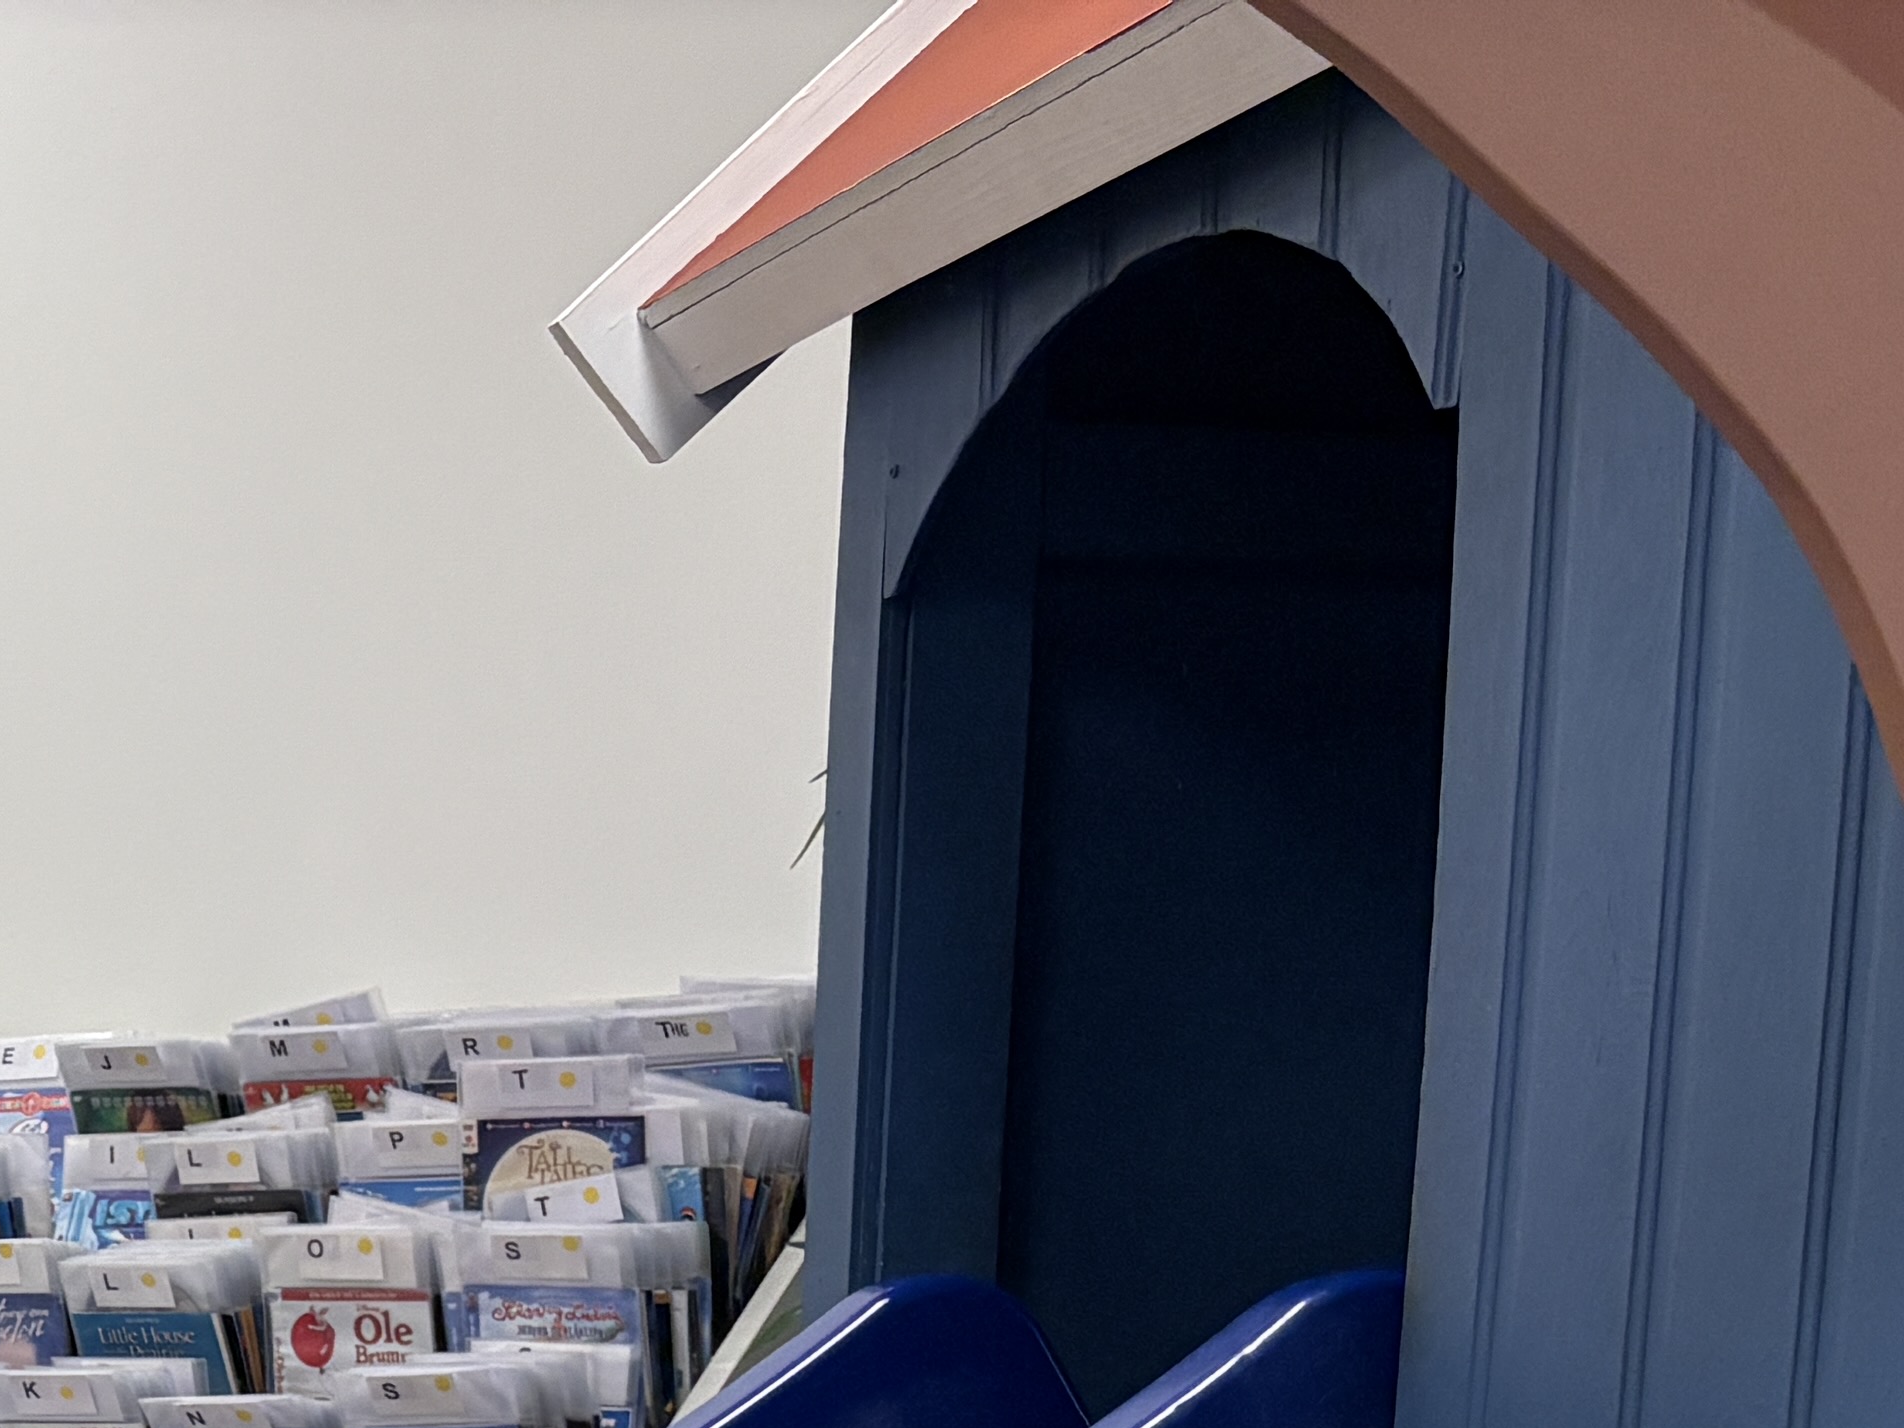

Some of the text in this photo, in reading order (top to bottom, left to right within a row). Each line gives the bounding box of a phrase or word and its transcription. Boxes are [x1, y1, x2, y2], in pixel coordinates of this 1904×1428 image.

[269, 1039, 288, 1057] M
[462, 1038, 480, 1055] R
[2, 1048, 15, 1064] E
[101, 1055, 112, 1070] J
[512, 1069, 528, 1089] T
[389, 1131, 405, 1150] P
[187, 1149, 202, 1167] L
[533, 1196, 550, 1217] T
[308, 1239, 323, 1258] O
[505, 1242, 521, 1260] S
[103, 1273, 119, 1291] L
[98, 1326, 196, 1345] Little House
[354, 1311, 413, 1345] Ole
[23, 1382, 41, 1399] K
[382, 1383, 400, 1400] S
[186, 1411, 206, 1427] N
